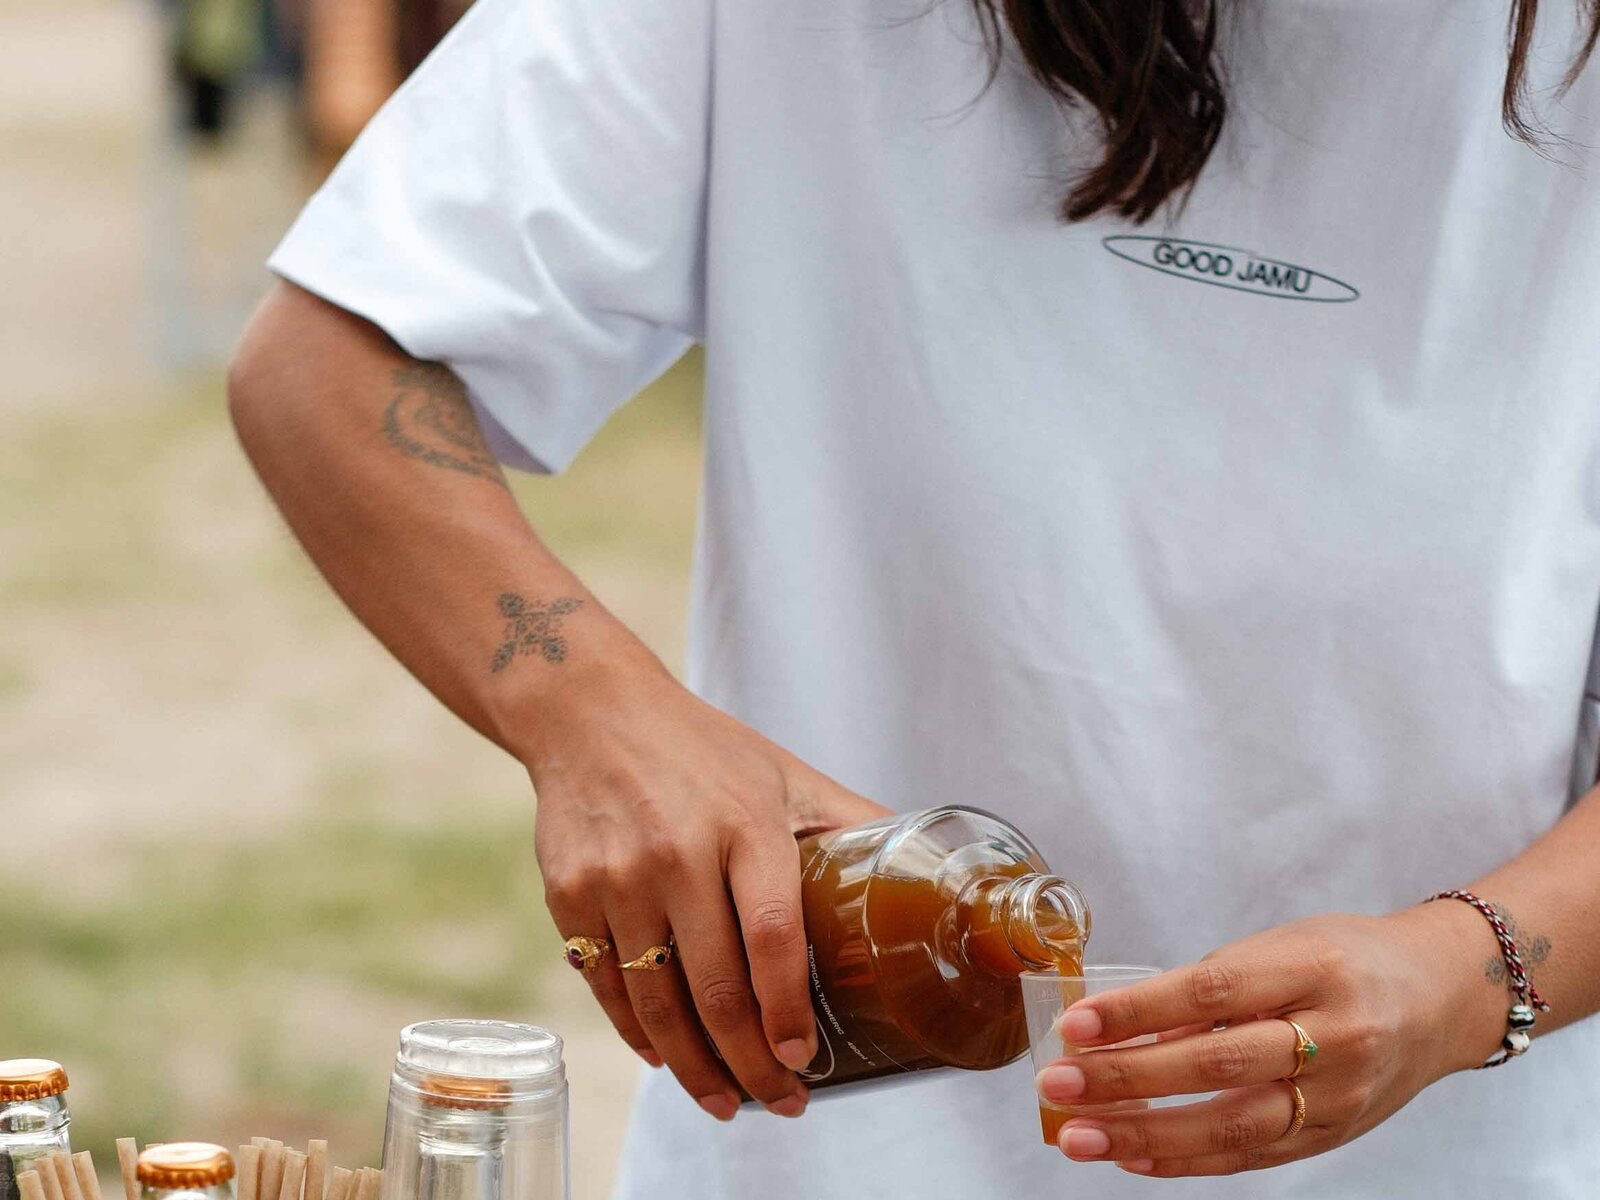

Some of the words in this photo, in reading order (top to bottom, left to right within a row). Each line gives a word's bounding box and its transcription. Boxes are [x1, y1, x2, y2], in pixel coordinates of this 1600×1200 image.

[1153, 243, 1233, 276] GOOD
[1237, 260, 1313, 293] JAMU
[808, 944, 820, 992] TROPICAL
[818, 992, 845, 1036] TURMERIC
